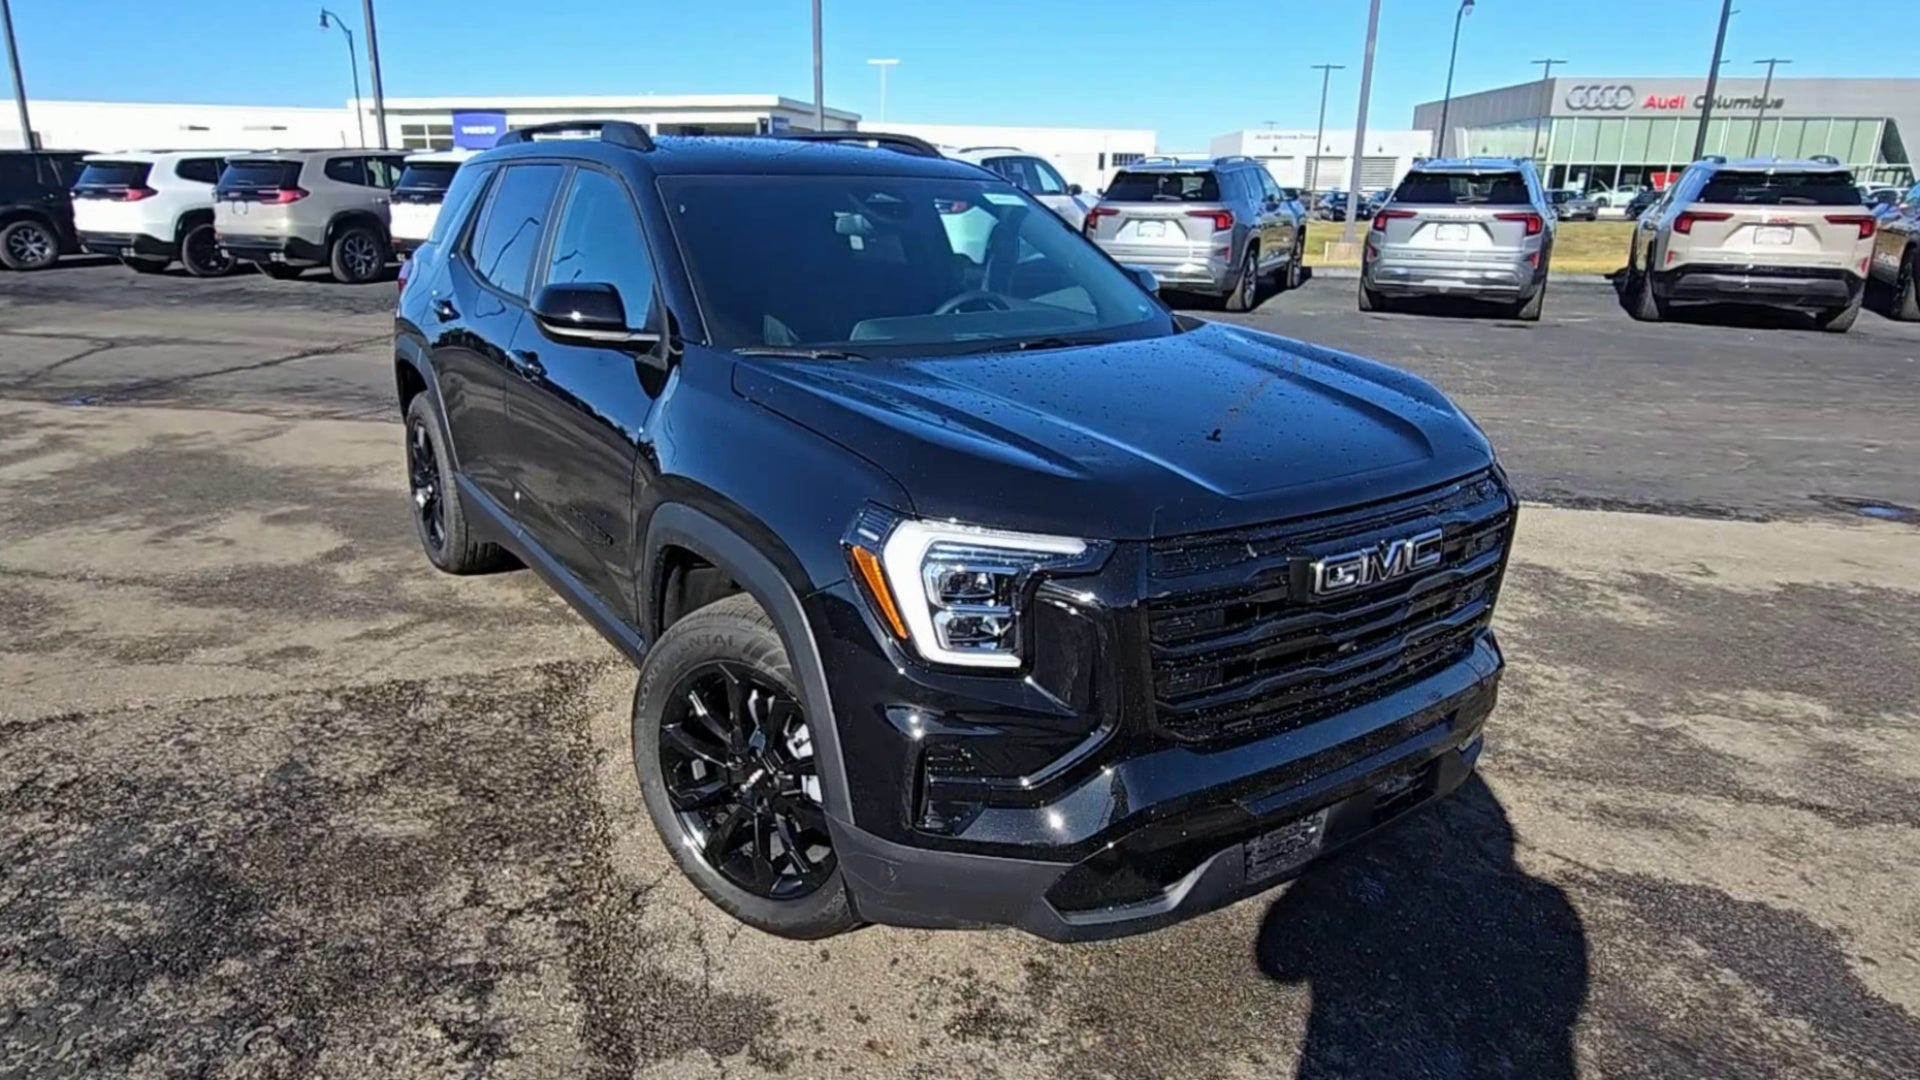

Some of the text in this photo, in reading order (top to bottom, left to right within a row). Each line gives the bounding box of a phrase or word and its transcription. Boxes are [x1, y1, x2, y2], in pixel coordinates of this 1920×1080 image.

[1643, 95, 1685, 109] Audi
[1314, 528, 1443, 594] GMC
[637, 633, 737, 712] CONNTAL
